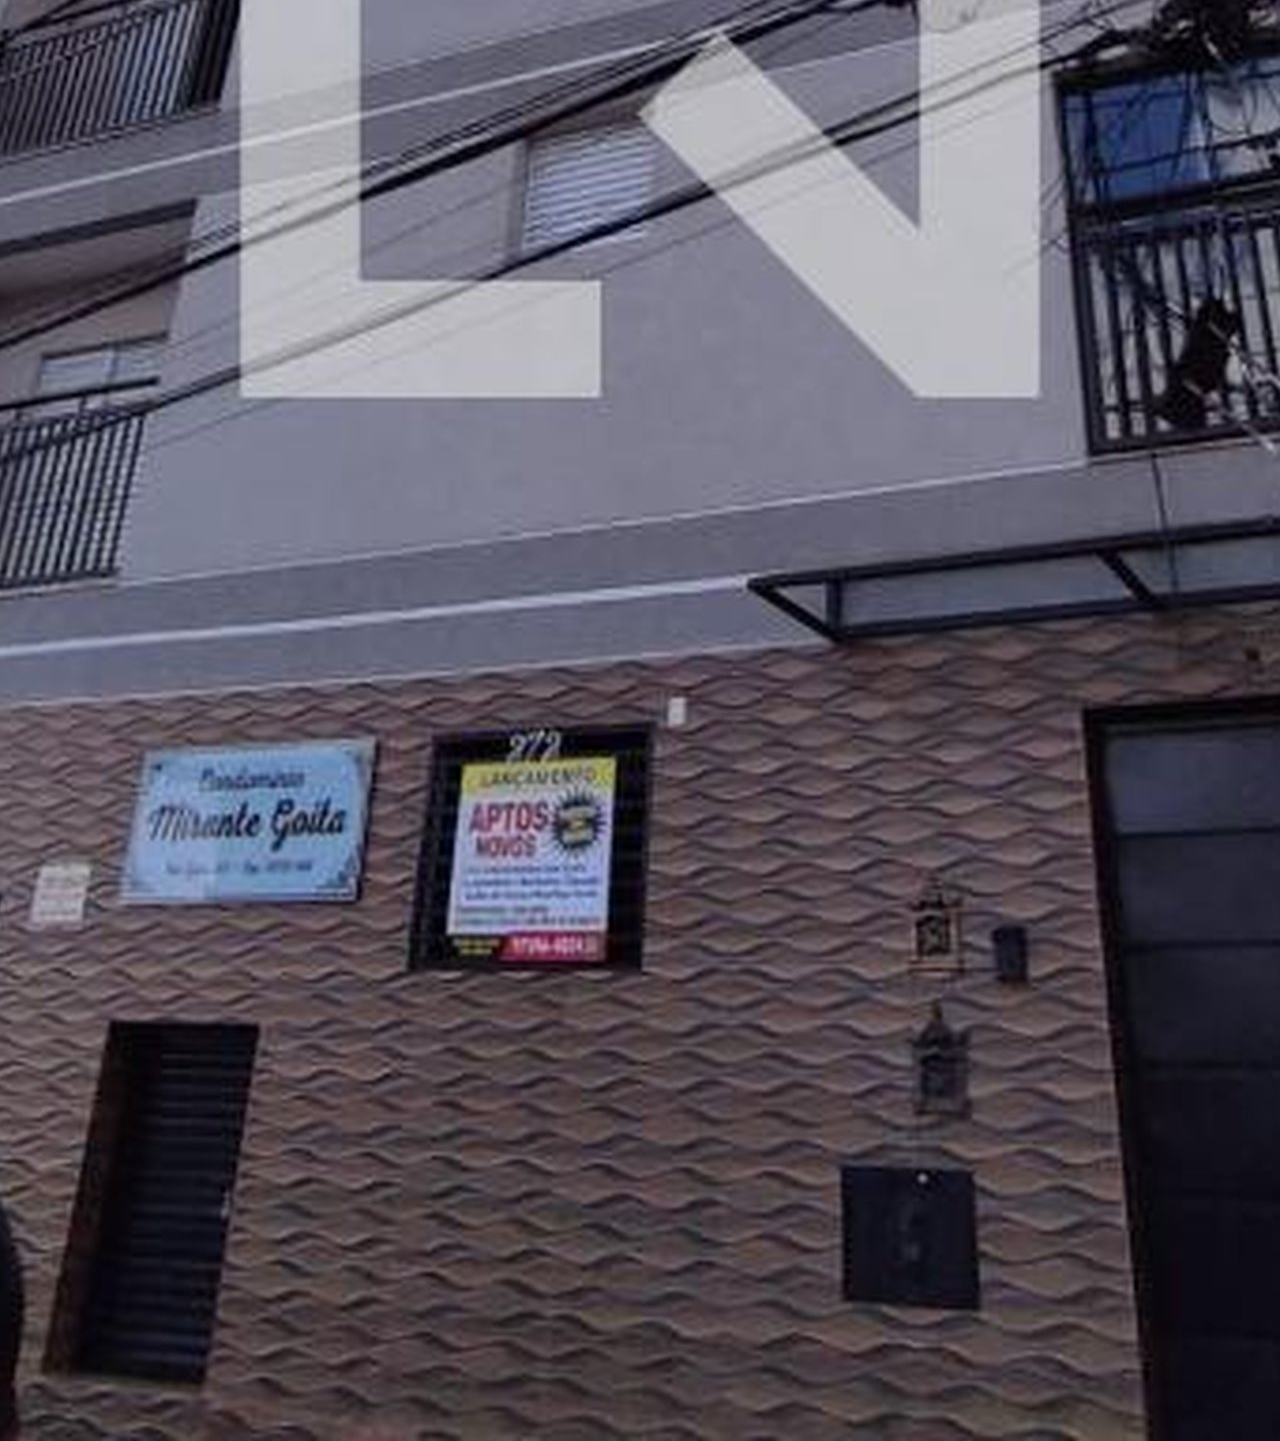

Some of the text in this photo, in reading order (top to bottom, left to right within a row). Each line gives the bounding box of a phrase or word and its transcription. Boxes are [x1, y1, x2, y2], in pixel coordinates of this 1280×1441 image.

[149, 802, 261, 841] Mirante
[470, 801, 549, 833] APTOS
[475, 834, 536, 857] NOVOS
